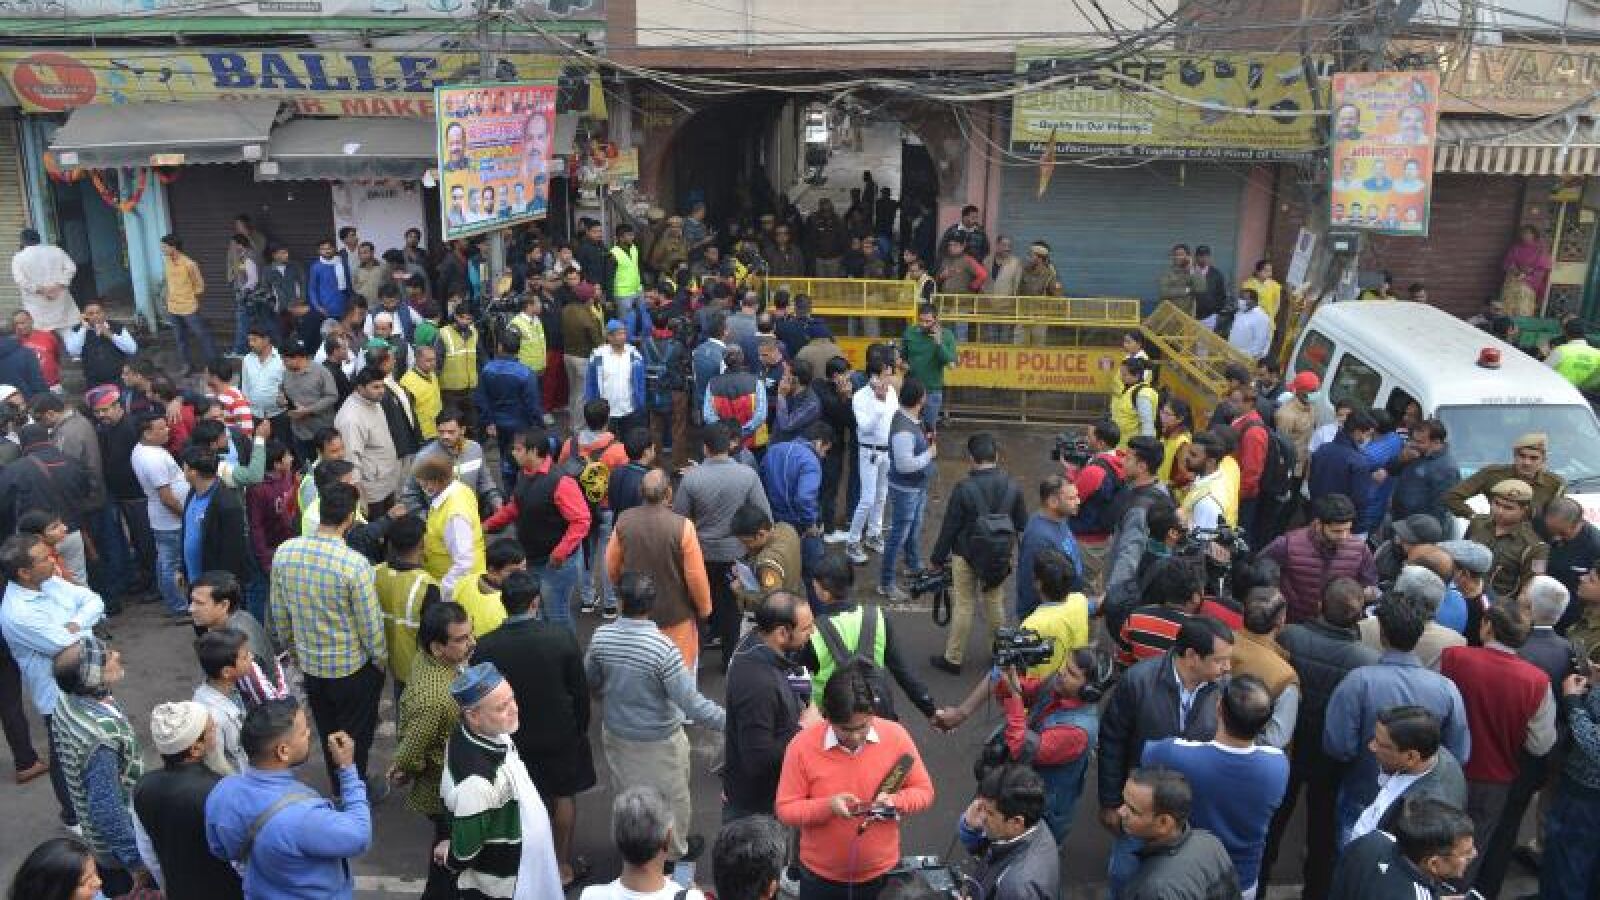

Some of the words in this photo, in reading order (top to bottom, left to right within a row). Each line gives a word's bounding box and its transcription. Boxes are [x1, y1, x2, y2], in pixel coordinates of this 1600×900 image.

[1029, 142, 1124, 157] Maufacturing
[957, 349, 1009, 371] DELHI
[1016, 351, 1089, 373] POLICE
